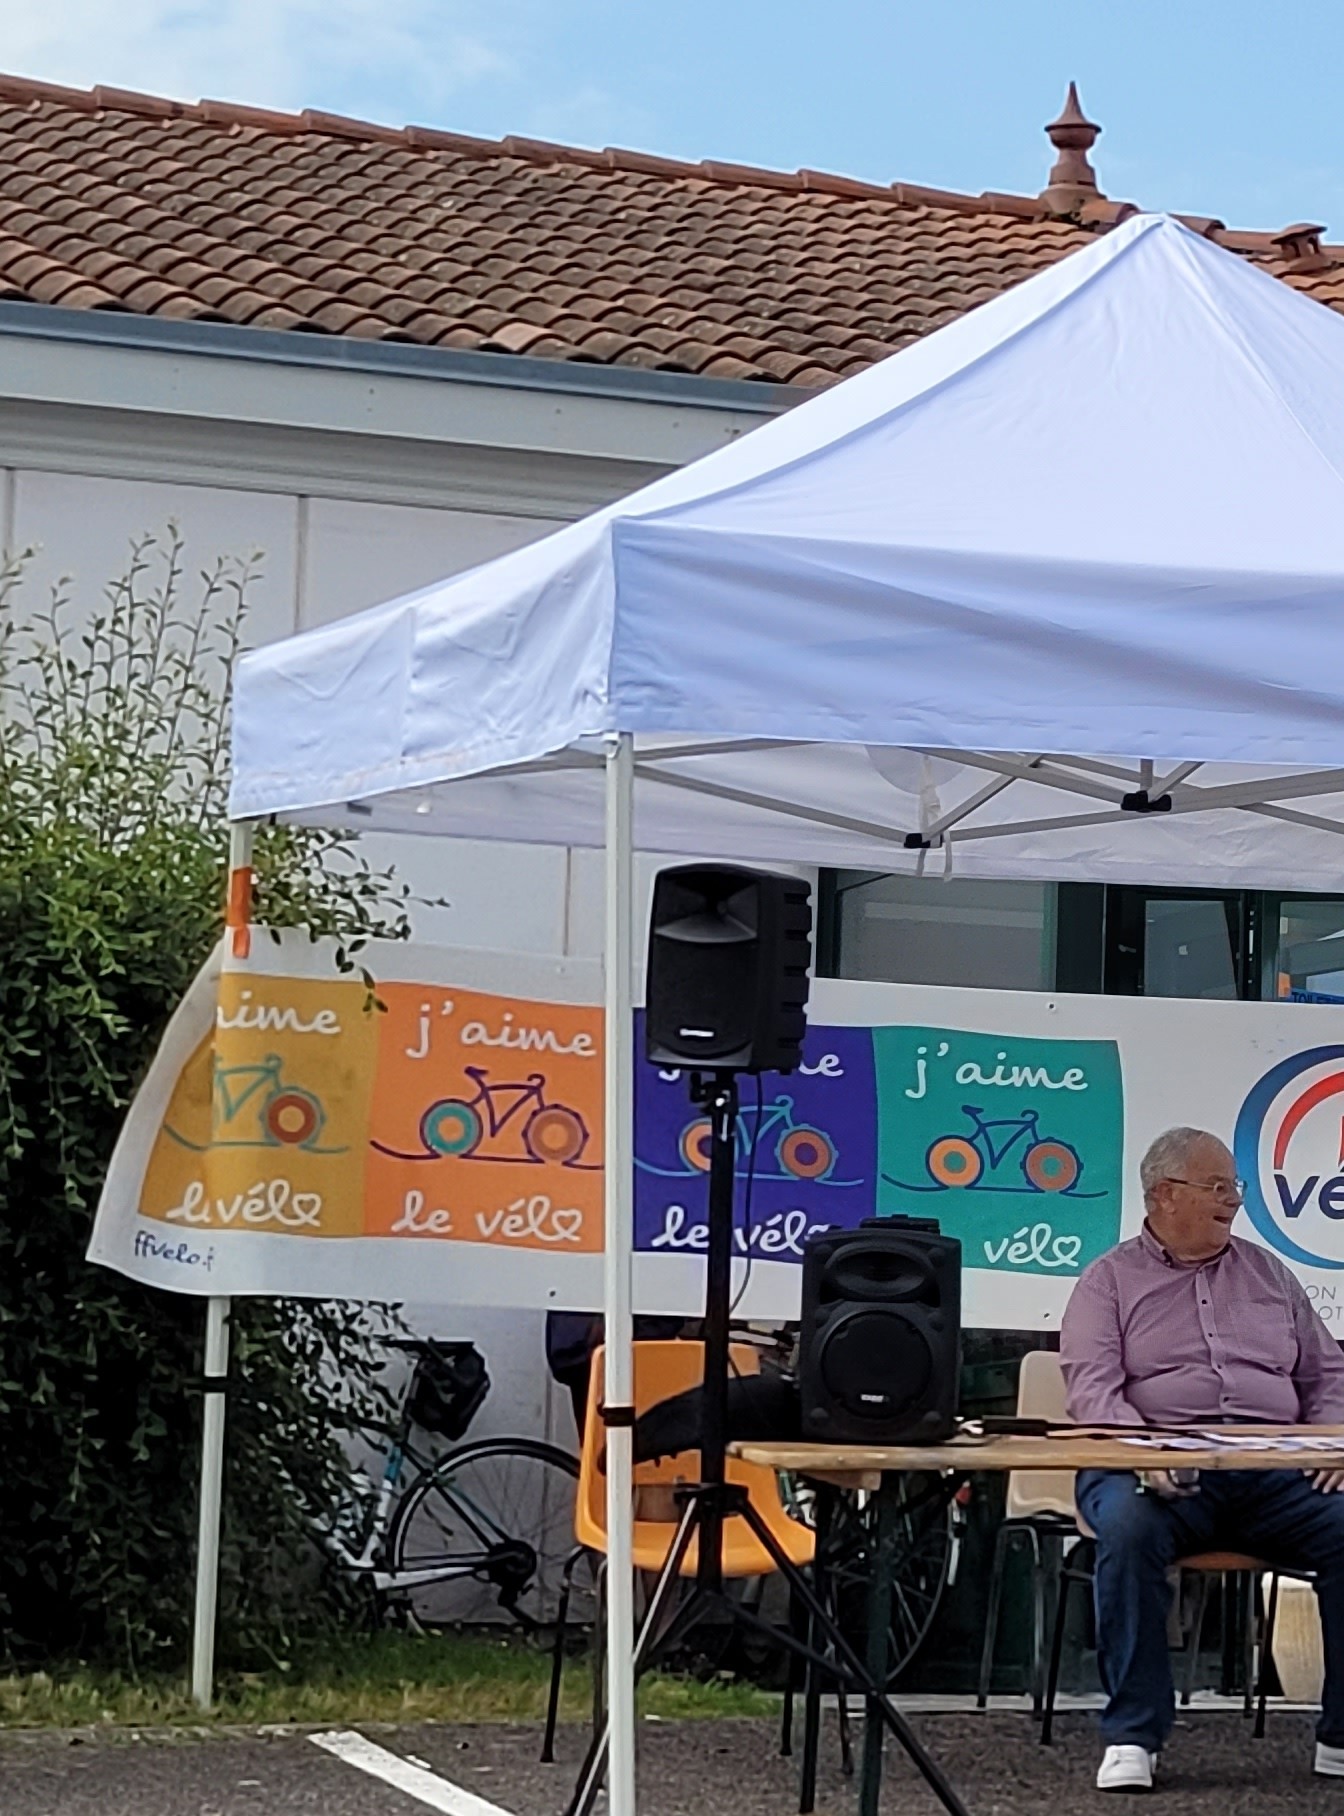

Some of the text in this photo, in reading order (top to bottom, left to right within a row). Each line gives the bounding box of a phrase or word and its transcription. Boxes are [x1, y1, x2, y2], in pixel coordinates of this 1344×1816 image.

[216, 990, 342, 1036] ime
[405, 1001, 598, 1059] j'aime
[904, 1042, 1090, 1099] j'aime
[391, 1190, 453, 1234] le
[651, 1206, 830, 1255] le vél
